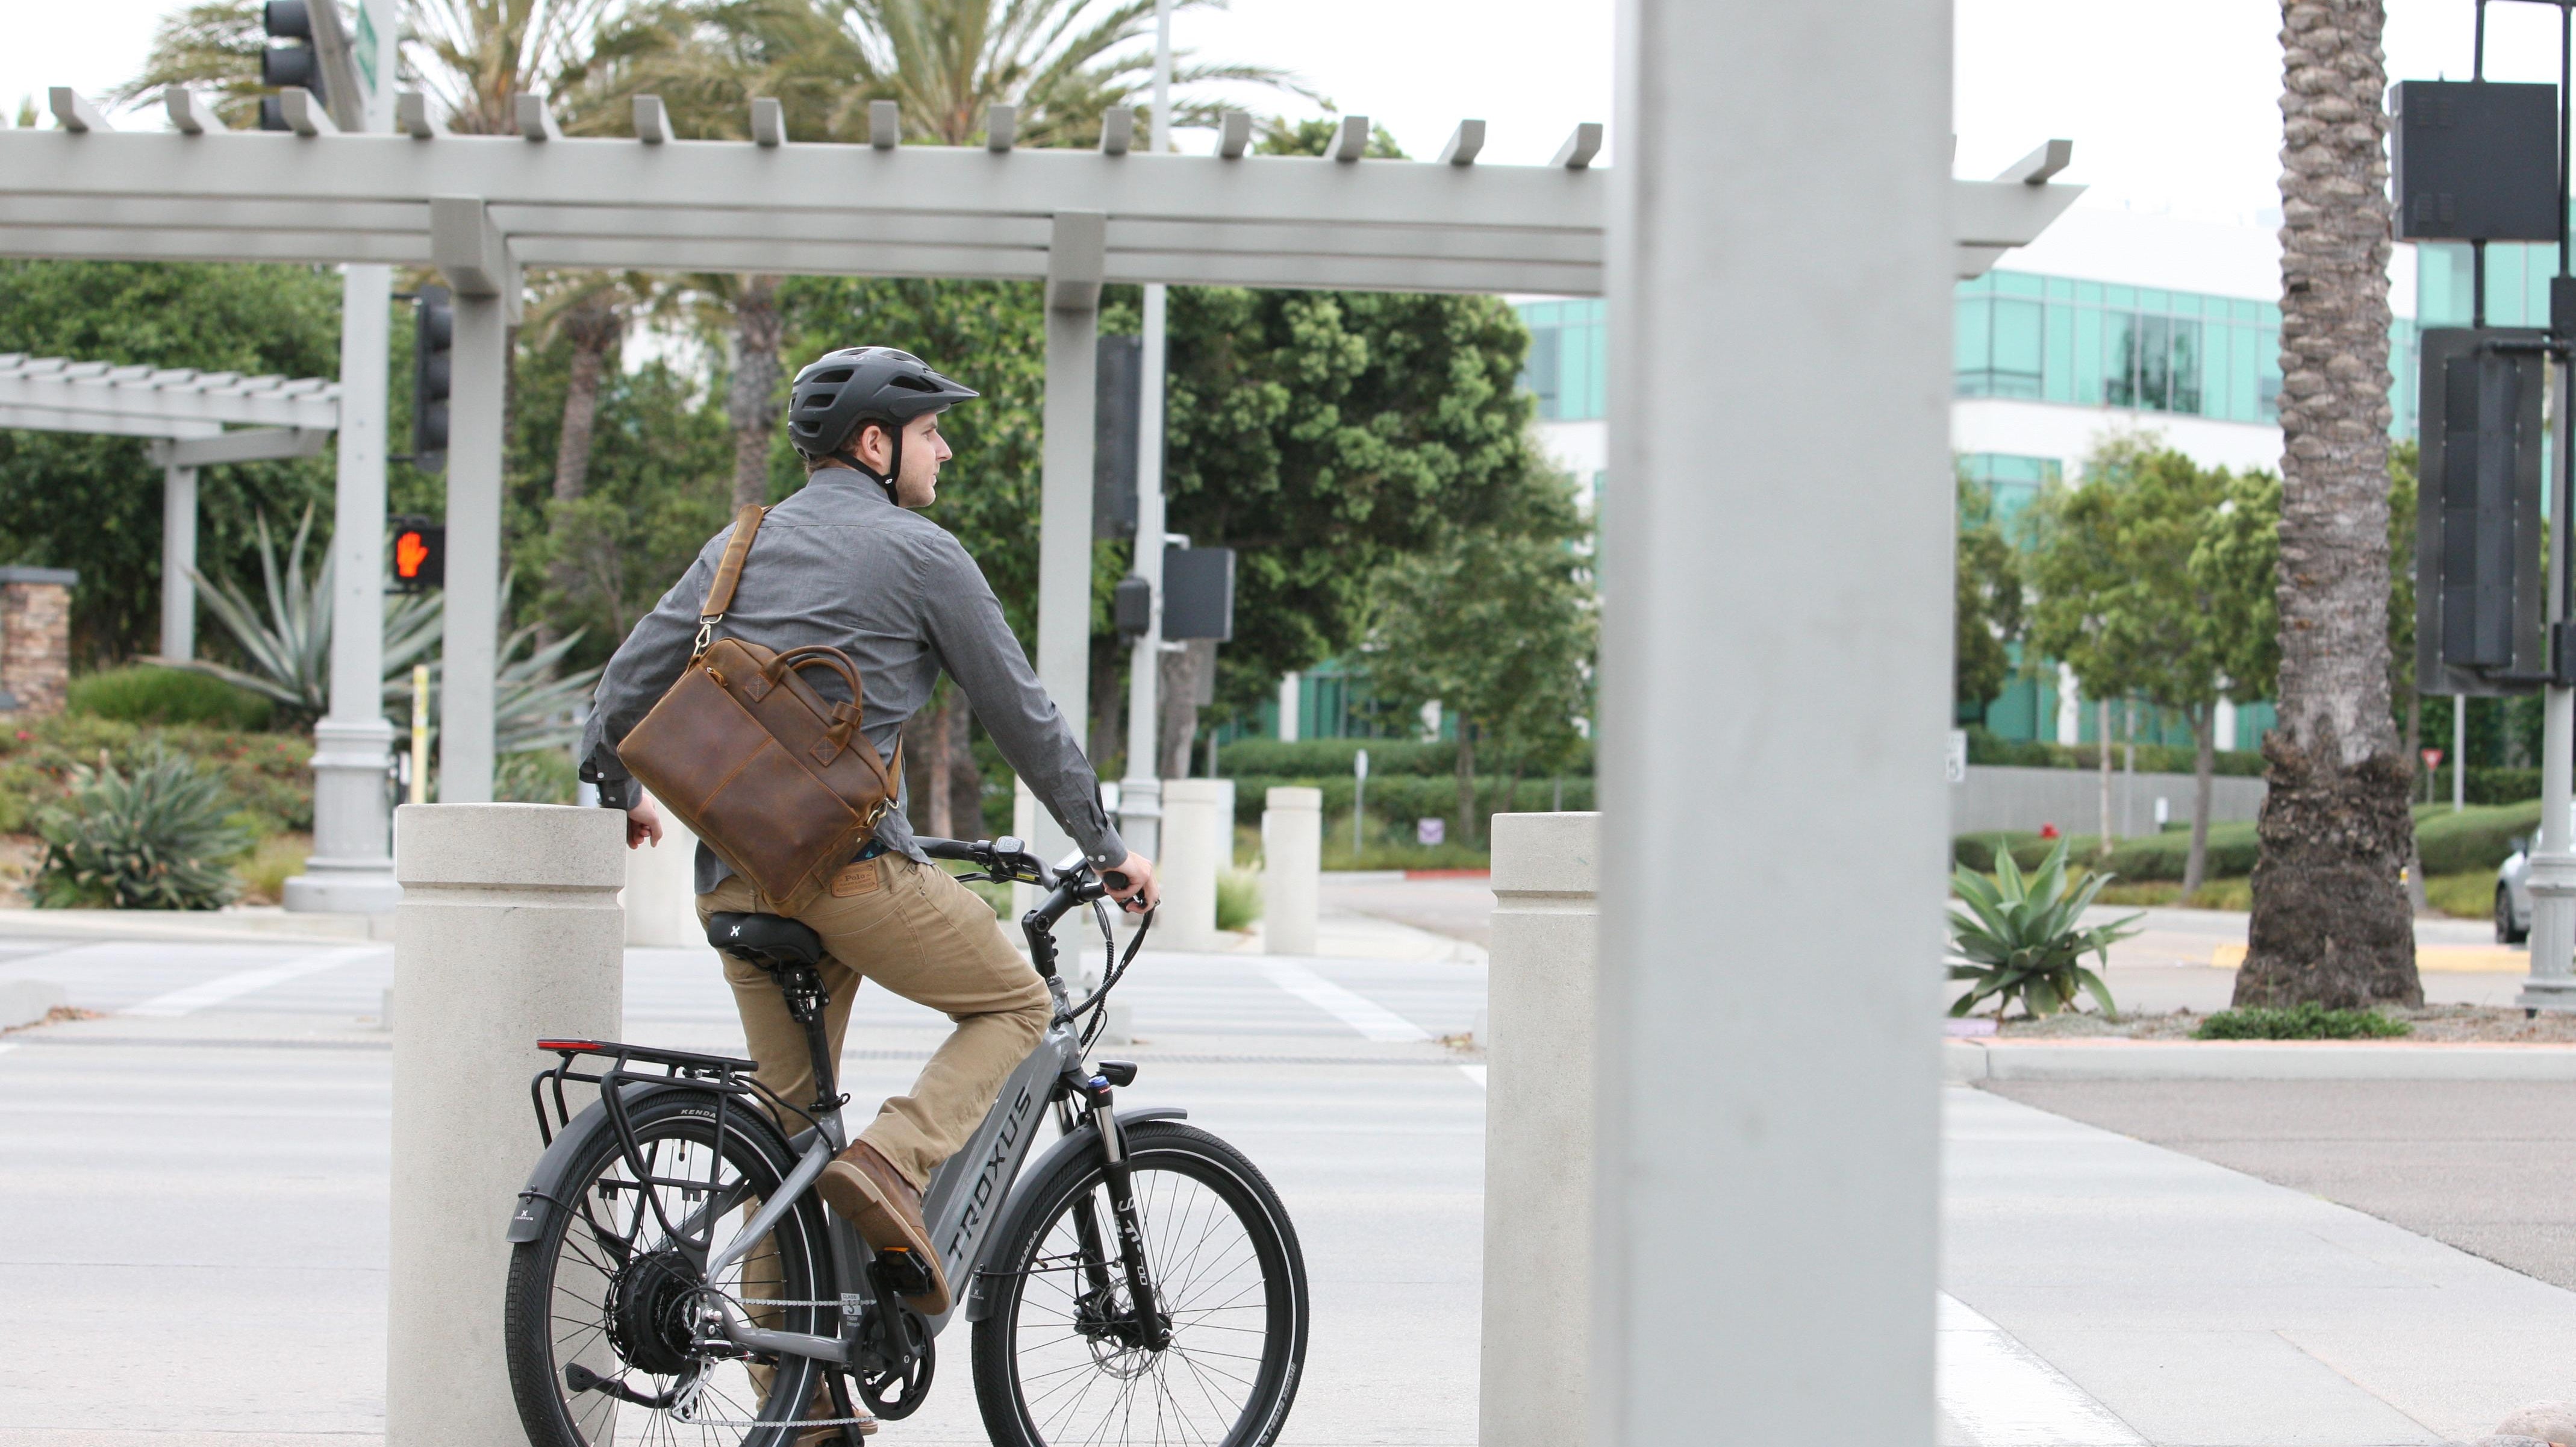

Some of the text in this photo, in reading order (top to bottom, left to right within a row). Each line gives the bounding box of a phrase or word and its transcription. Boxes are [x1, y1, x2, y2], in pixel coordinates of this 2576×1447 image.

[681, 1109, 716, 1119] KENDA
[947, 1086, 1031, 1261] TROXUS
[1016, 1230, 1038, 1272] KENDA
